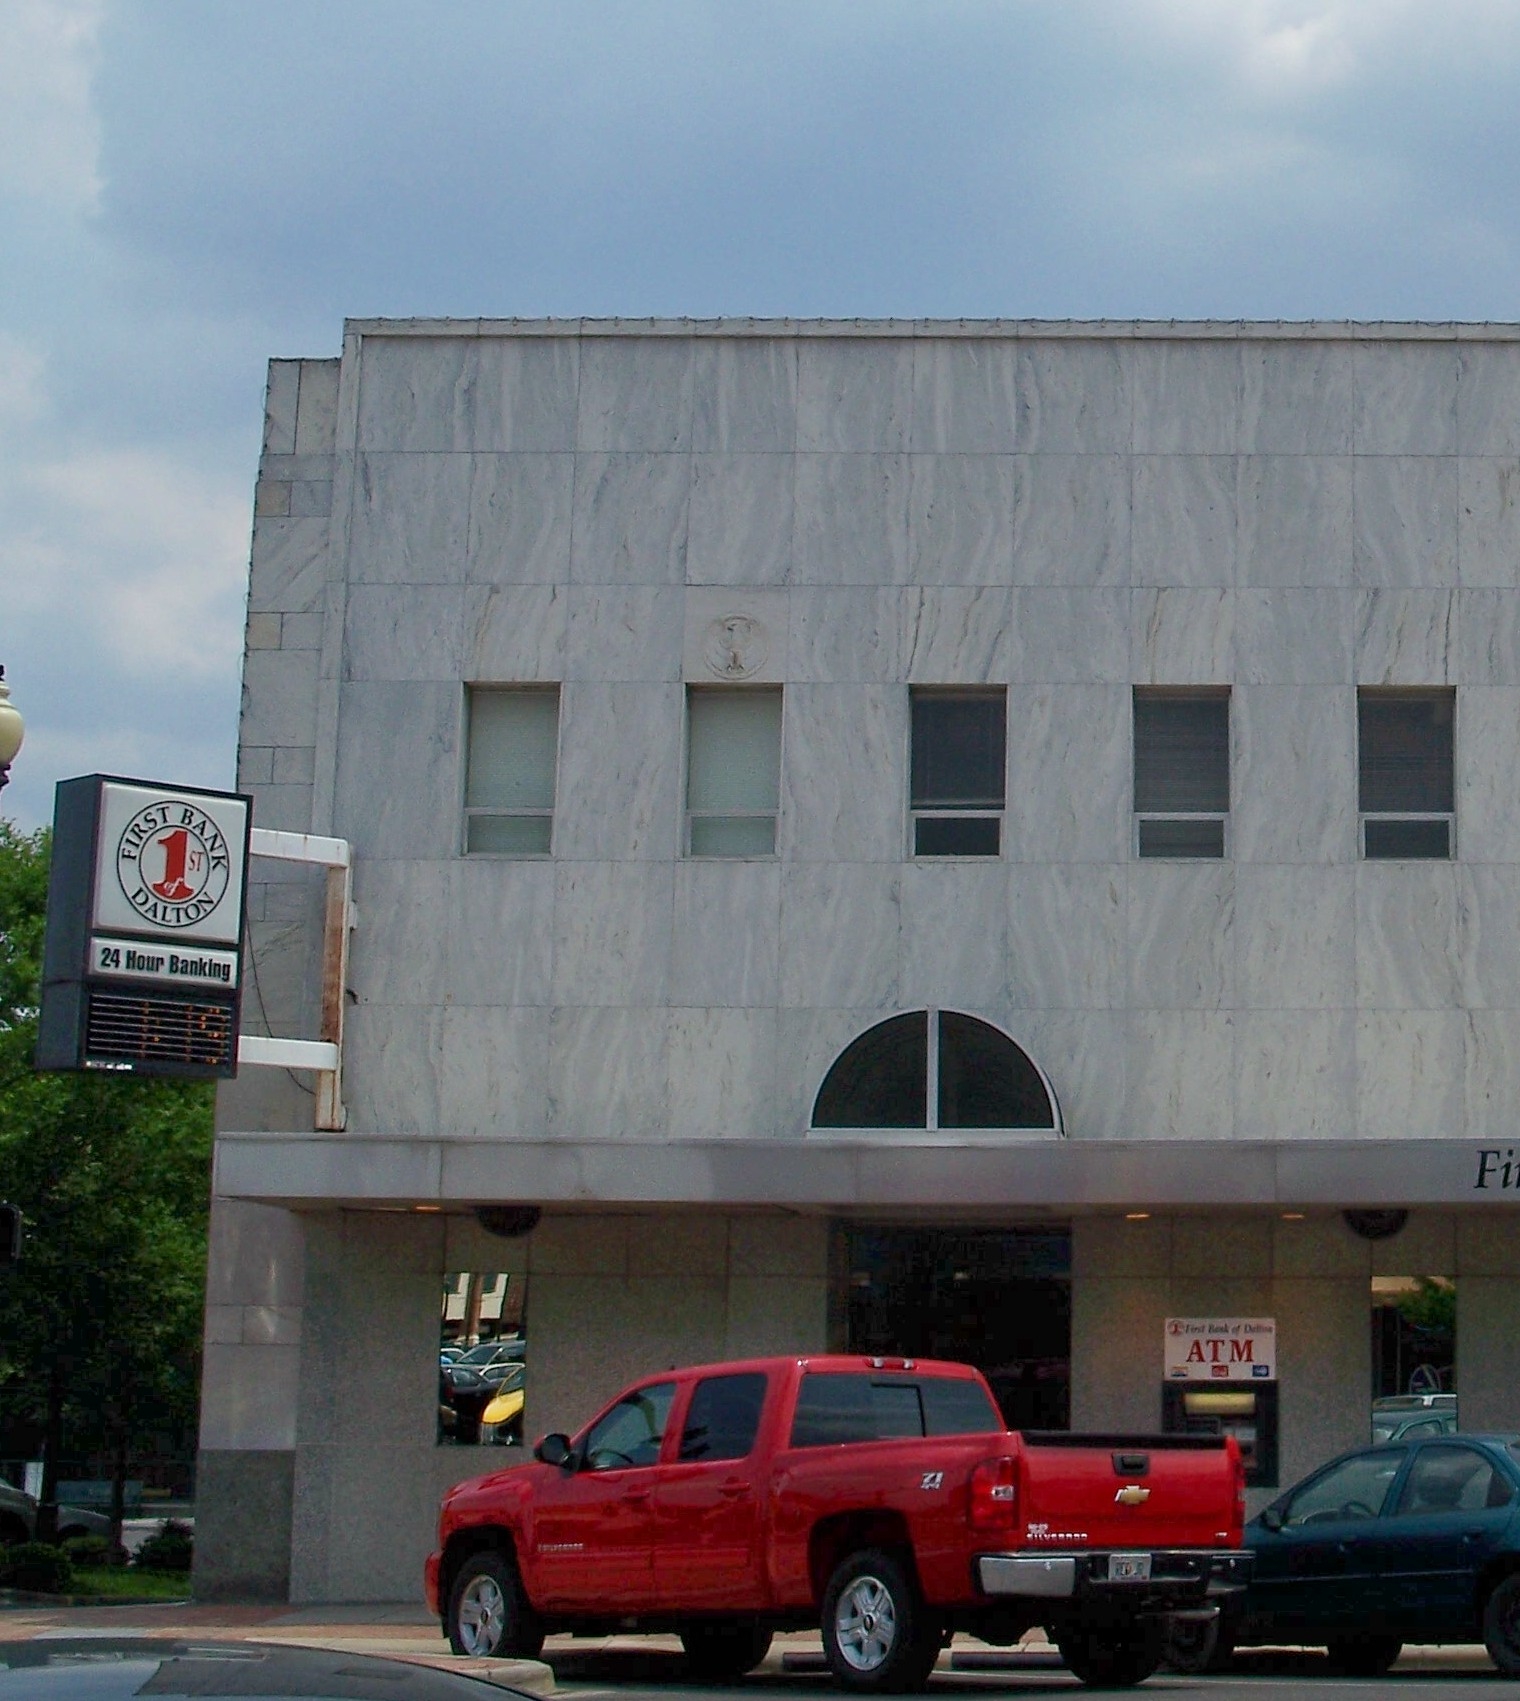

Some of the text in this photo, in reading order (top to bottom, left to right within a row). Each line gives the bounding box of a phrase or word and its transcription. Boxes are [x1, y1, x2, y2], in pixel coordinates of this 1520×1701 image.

[121, 806, 227, 871] FIRST BANK
[164, 877, 184, 896] of
[132, 888, 214, 923] DALTON
[100, 947, 231, 982] 24 Hour Banking
[1185, 1323, 1206, 1334] First
[1208, 1323, 1229, 1334] Bank
[1232, 1325, 1241, 1337] of
[1244, 1323, 1274, 1334] Dalton
[1186, 1339, 1254, 1363] ATM
